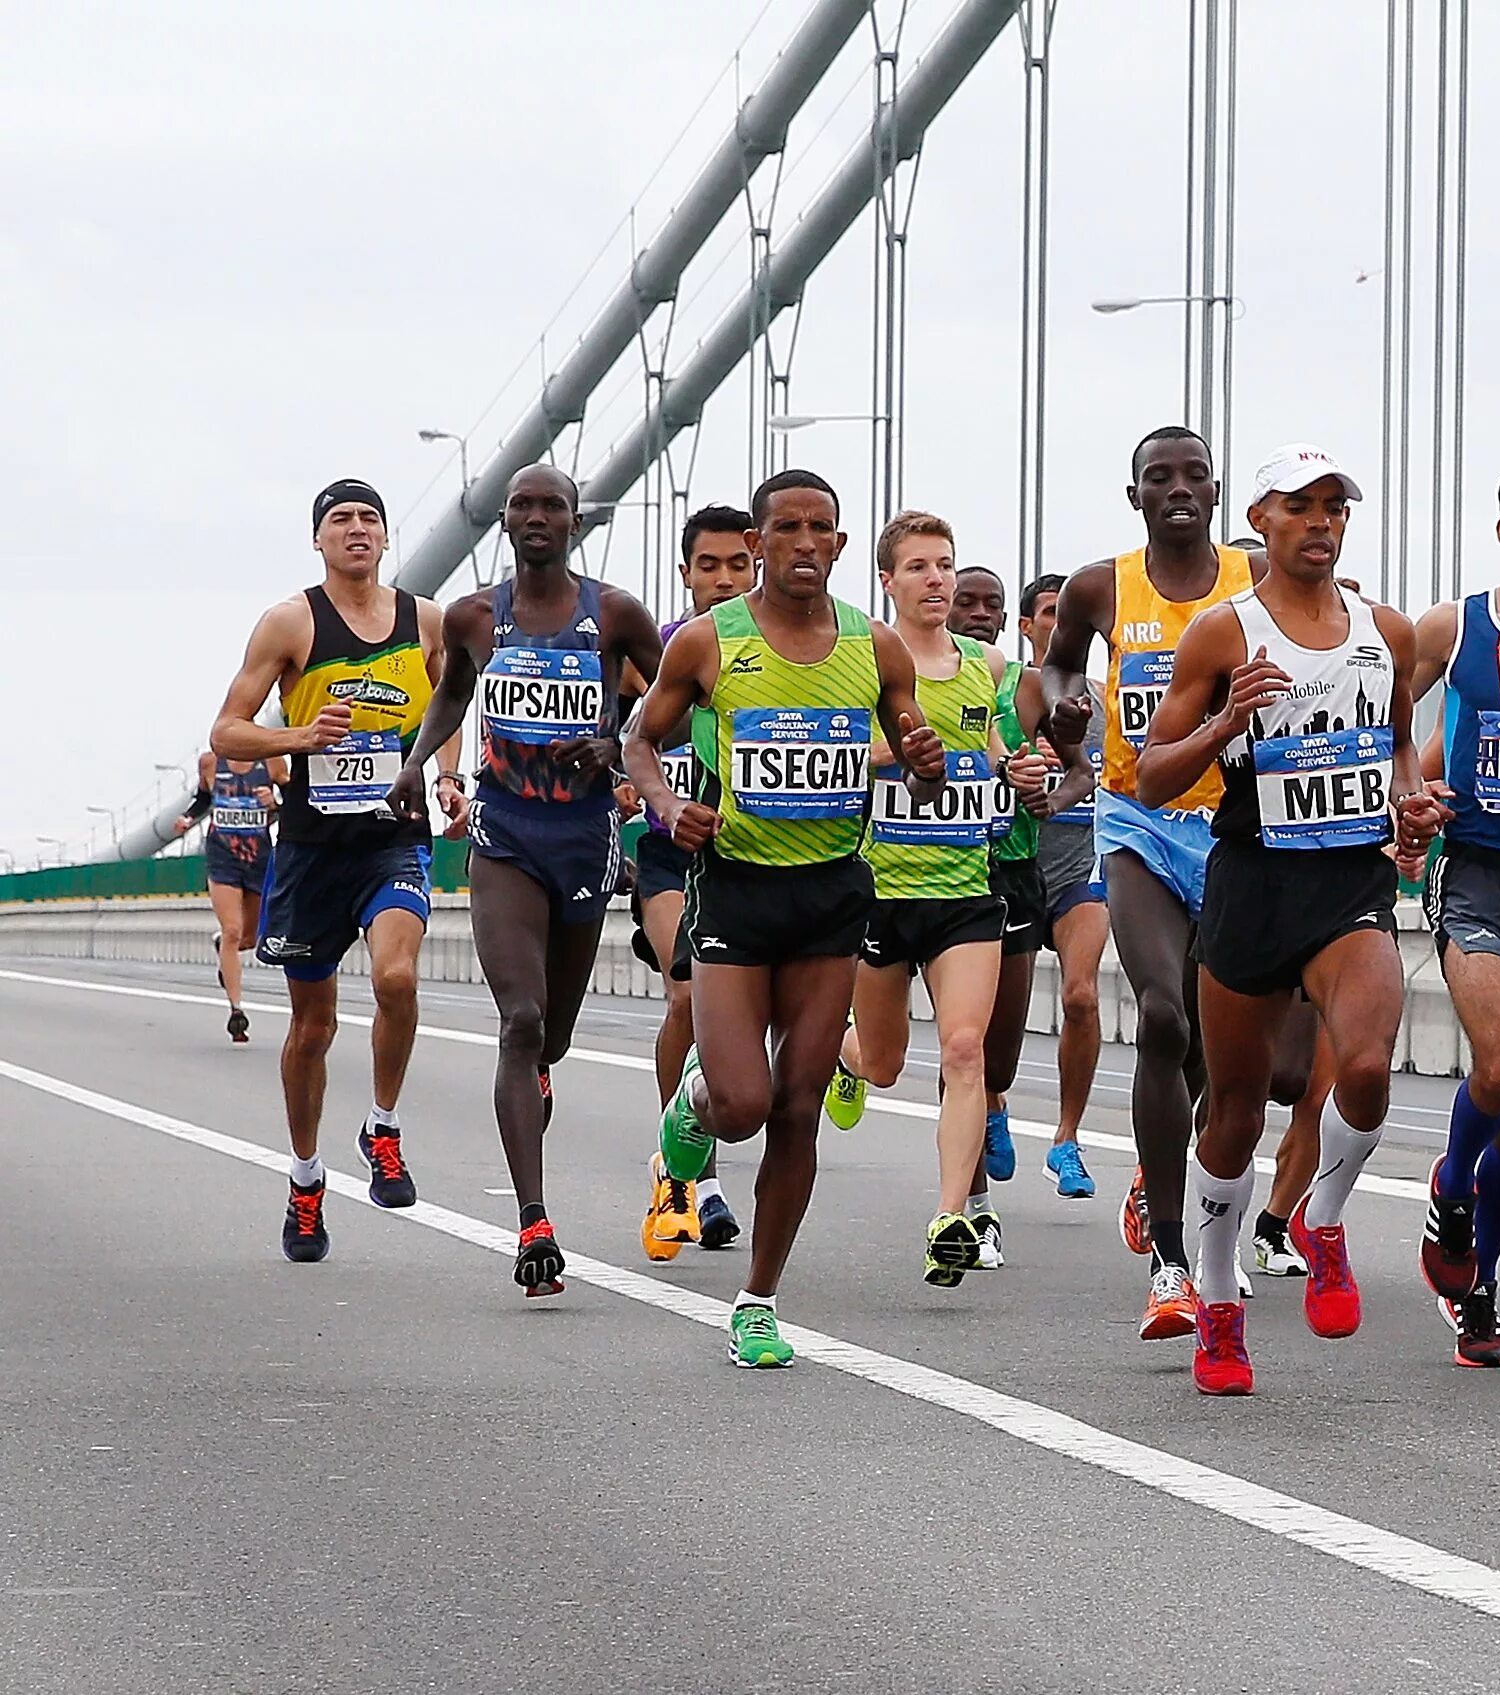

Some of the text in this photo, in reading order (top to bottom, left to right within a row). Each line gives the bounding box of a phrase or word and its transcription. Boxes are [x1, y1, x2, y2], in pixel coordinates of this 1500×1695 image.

[1122, 621, 1162, 643] NRC
[518, 650, 537, 659] TATA
[1157, 655, 1176, 663] TAT
[504, 656, 551, 668] CONSULTANCY
[510, 665, 541, 675] SERVICES
[560, 668, 581, 676] TATA
[1144, 664, 1174, 673] CONSUL
[366, 686, 407, 704] COURSE
[485, 678, 598, 721] KIPSANG
[777, 712, 803, 722] TATA
[760, 721, 819, 731] CONSULTANCY
[771, 730, 809, 739] SERVICES
[828, 729, 851, 738] TATA
[1301, 737, 1329, 748] TATA
[1285, 744, 1347, 759] CONSULTANCY
[1357, 747, 1378, 758] TATA
[1297, 755, 1336, 768] SERVICES
[336, 756, 374, 781] 279
[735, 748, 867, 790] TSEGAY
[955, 768, 976, 776] TATA
[1283, 769, 1385, 820] MEB
[885, 784, 983, 821] LEON
